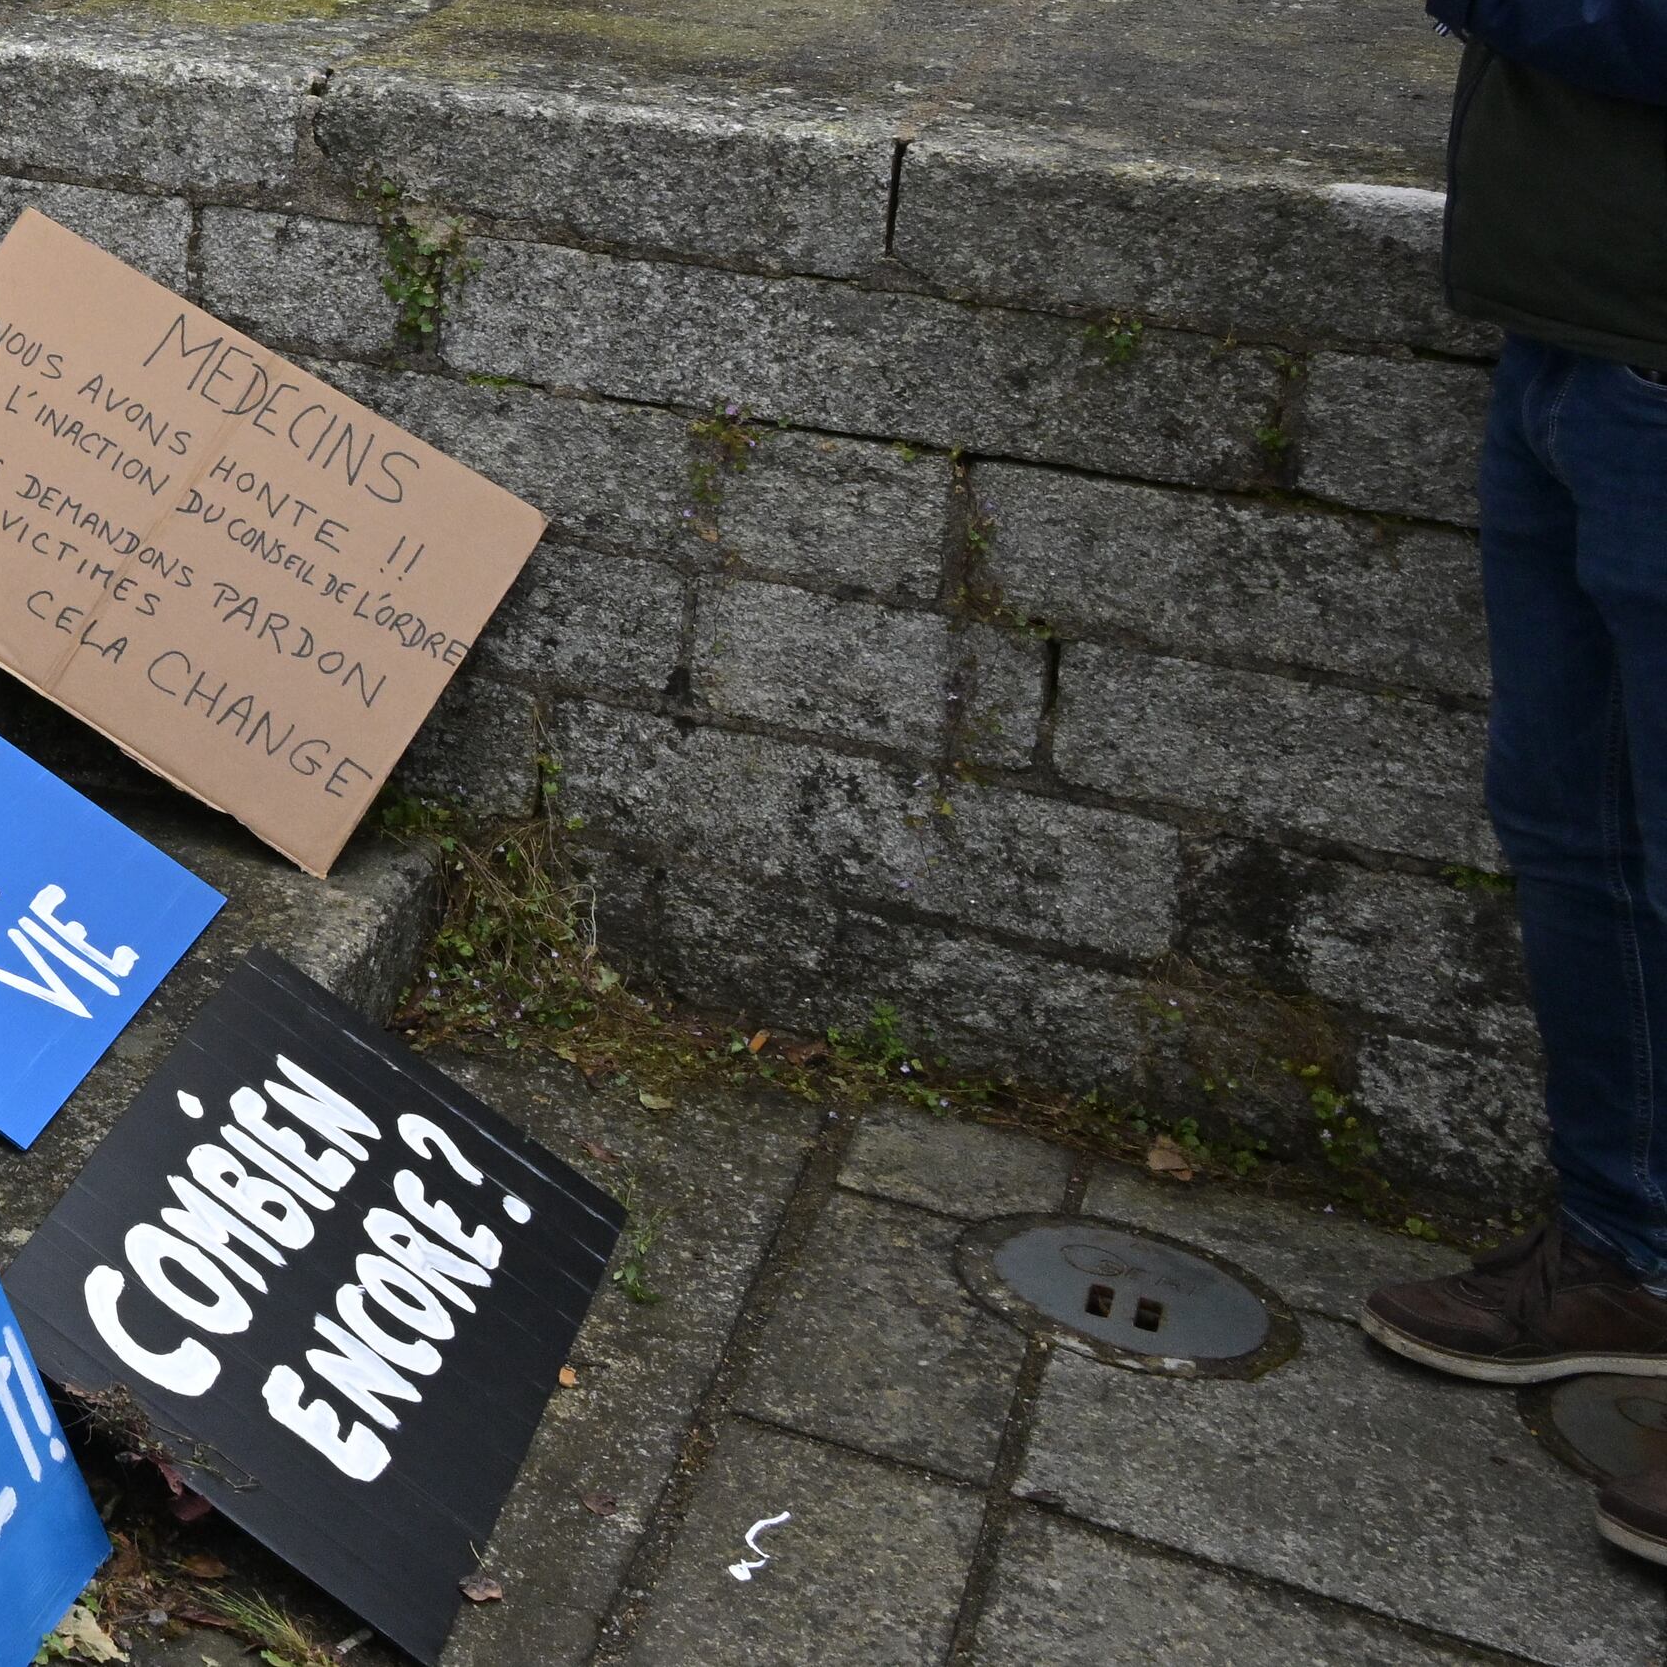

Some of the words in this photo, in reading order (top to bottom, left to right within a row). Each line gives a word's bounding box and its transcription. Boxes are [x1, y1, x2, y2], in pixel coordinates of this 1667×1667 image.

[77, 373, 193, 456] AVONS
[209, 454, 351, 555] HONTE
[385, 534, 427, 584] !!
[142, 313, 423, 505] MEDECINS
[0, 513, 162, 618] VICTIMES
[4, 385, 171, 497] L'INACTION
[175, 488, 225, 531] DU
[226, 516, 338, 591] CONSEIL
[322, 570, 358, 605] DE
[354, 590, 470, 668] L'ORDRE
[15, 474, 194, 588] DEMANDONS
[213, 580, 389, 709] PARDON
[25, 590, 130, 664] CELA
[146, 650, 375, 800] CHANGE
[259, 1107, 536, 1485] ENCORE?
